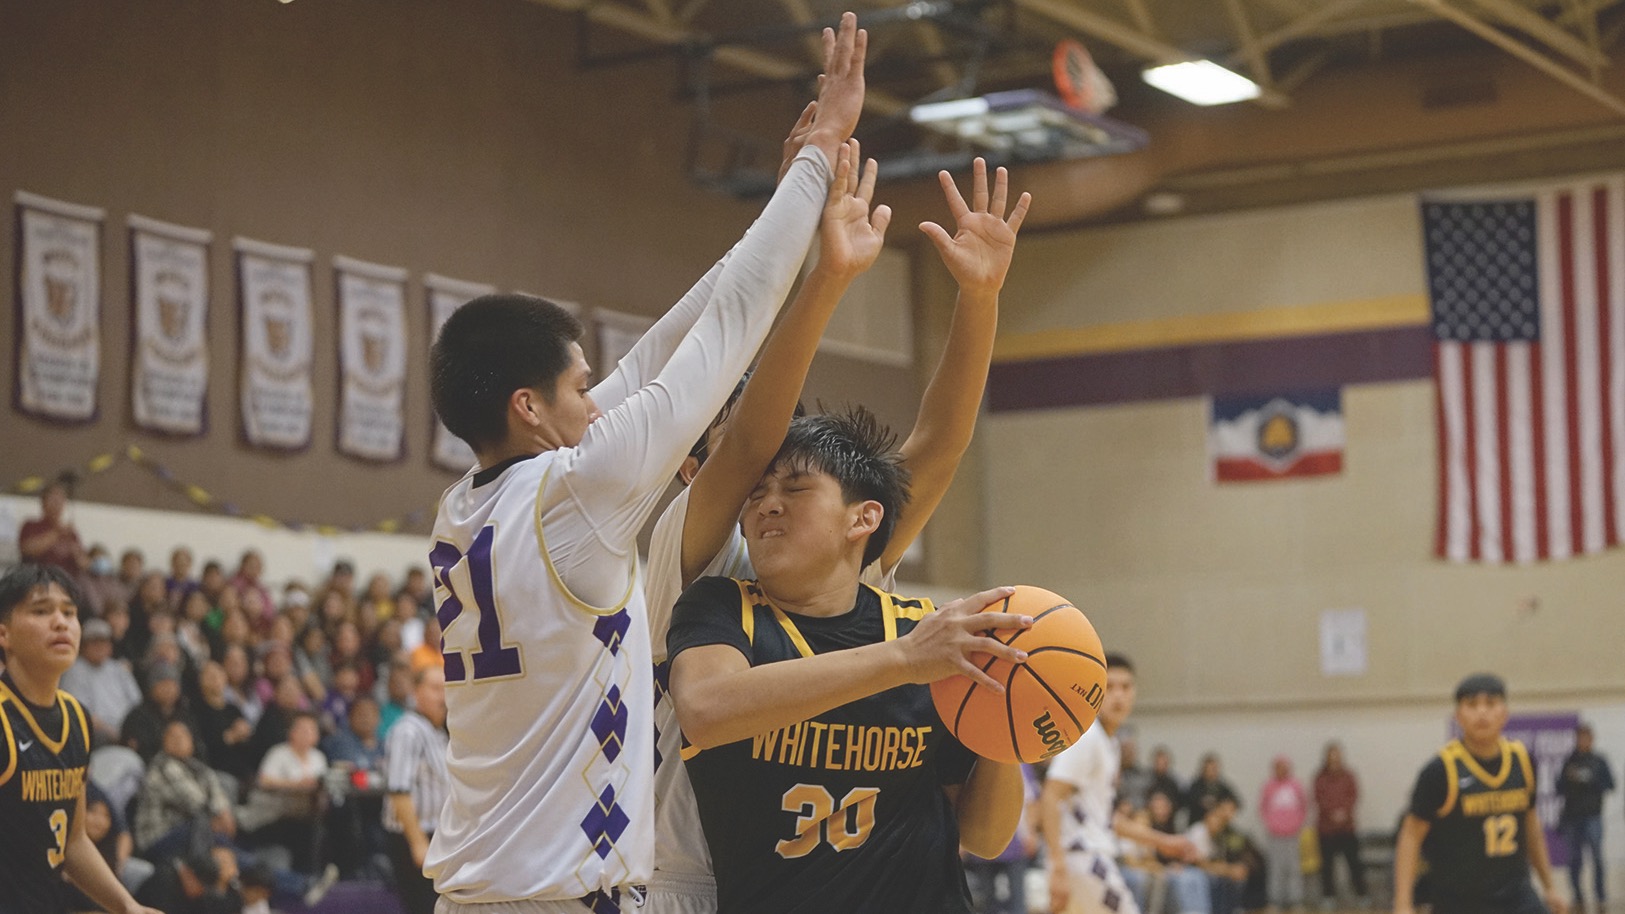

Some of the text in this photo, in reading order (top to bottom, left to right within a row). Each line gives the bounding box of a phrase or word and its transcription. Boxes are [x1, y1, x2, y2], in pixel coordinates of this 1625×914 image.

[428, 521, 526, 687] 21
[1070, 683, 1105, 714] VO NXT
[752, 721, 932, 771] WHITEHORSE
[1033, 710, 1067, 759] lson
[47, 808, 68, 869] 3
[774, 783, 881, 859] 30
[1483, 814, 1518, 857] 12
